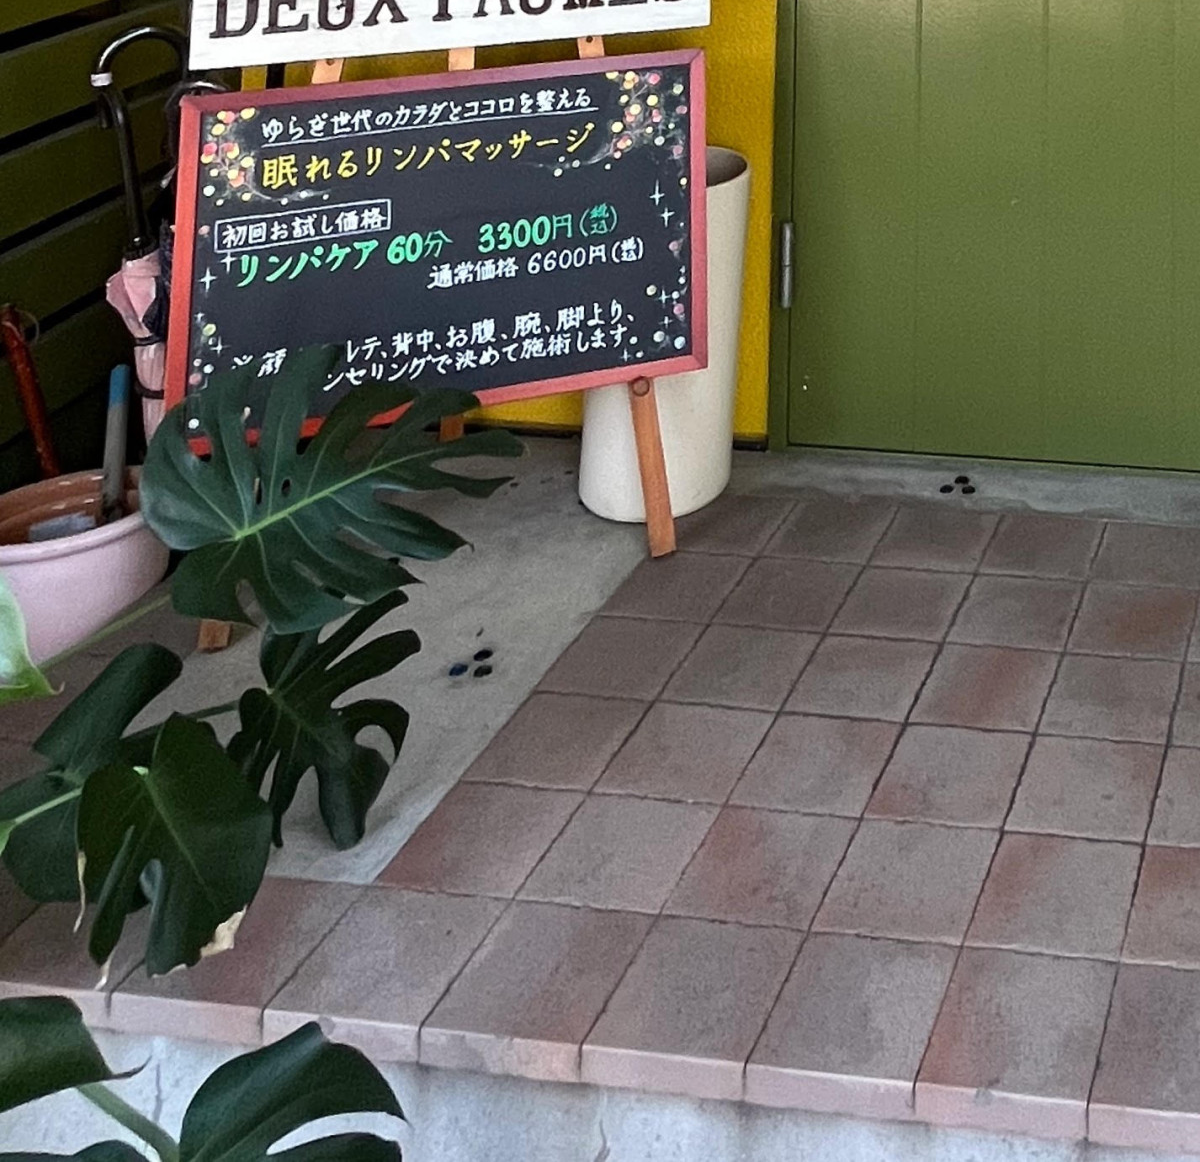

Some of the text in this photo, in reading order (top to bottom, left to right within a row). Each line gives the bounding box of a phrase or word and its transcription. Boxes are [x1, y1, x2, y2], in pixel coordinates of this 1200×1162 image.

[262, 122, 596, 190] 眠れるリンパマッサージ
[221, 208, 386, 248] 初回お試し価格
[237, 239, 379, 287] リンパケア
[387, 230, 453, 265] 60分
[426, 257, 519, 289] 通常価格
